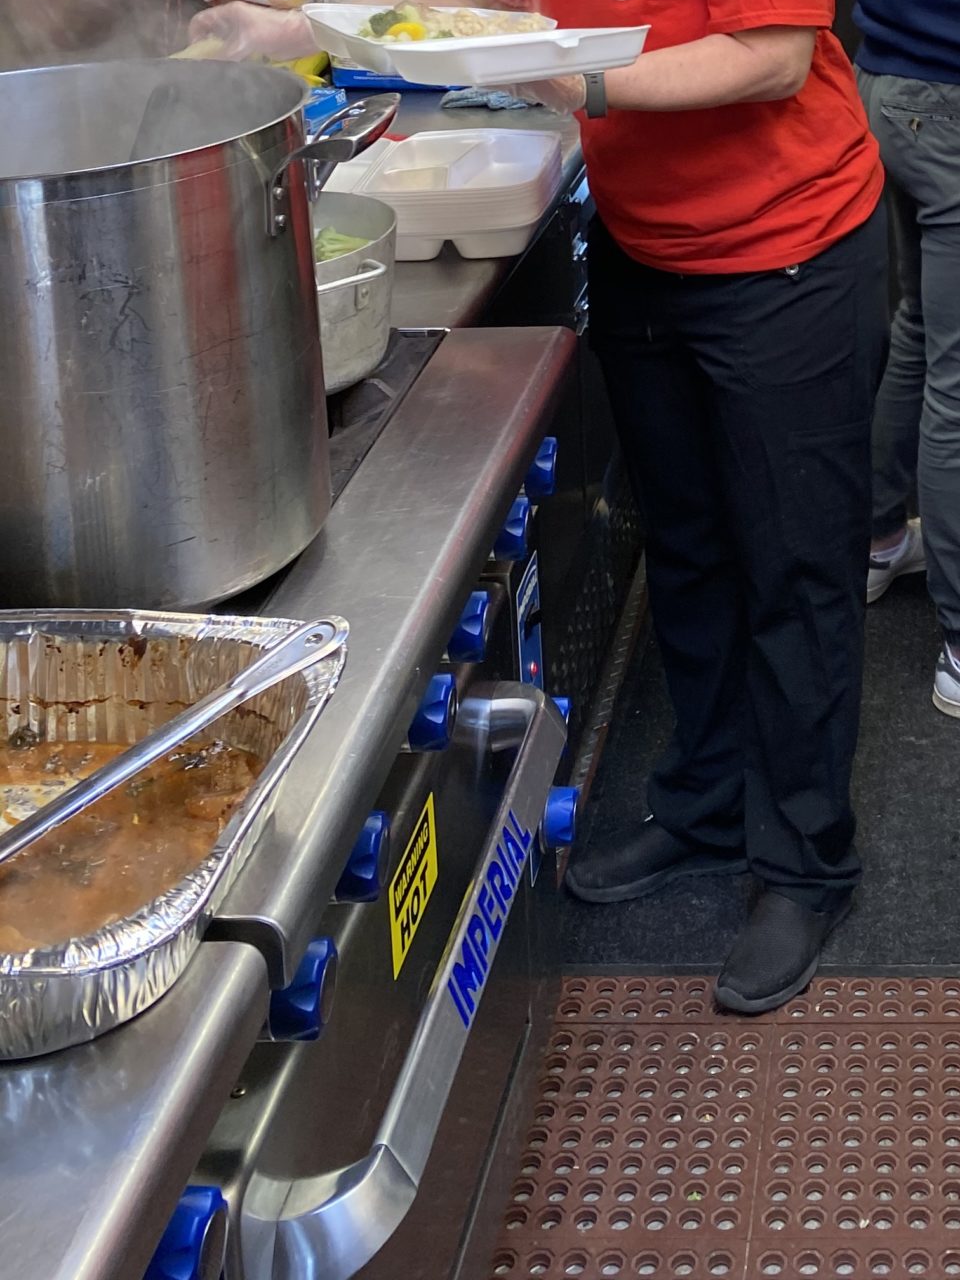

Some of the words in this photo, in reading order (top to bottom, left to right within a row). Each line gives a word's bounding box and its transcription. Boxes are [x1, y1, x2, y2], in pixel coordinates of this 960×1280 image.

[393, 820, 430, 905] WARNING
[399, 862, 430, 955] HOT
[446, 809, 534, 1030] IMPERIAL
